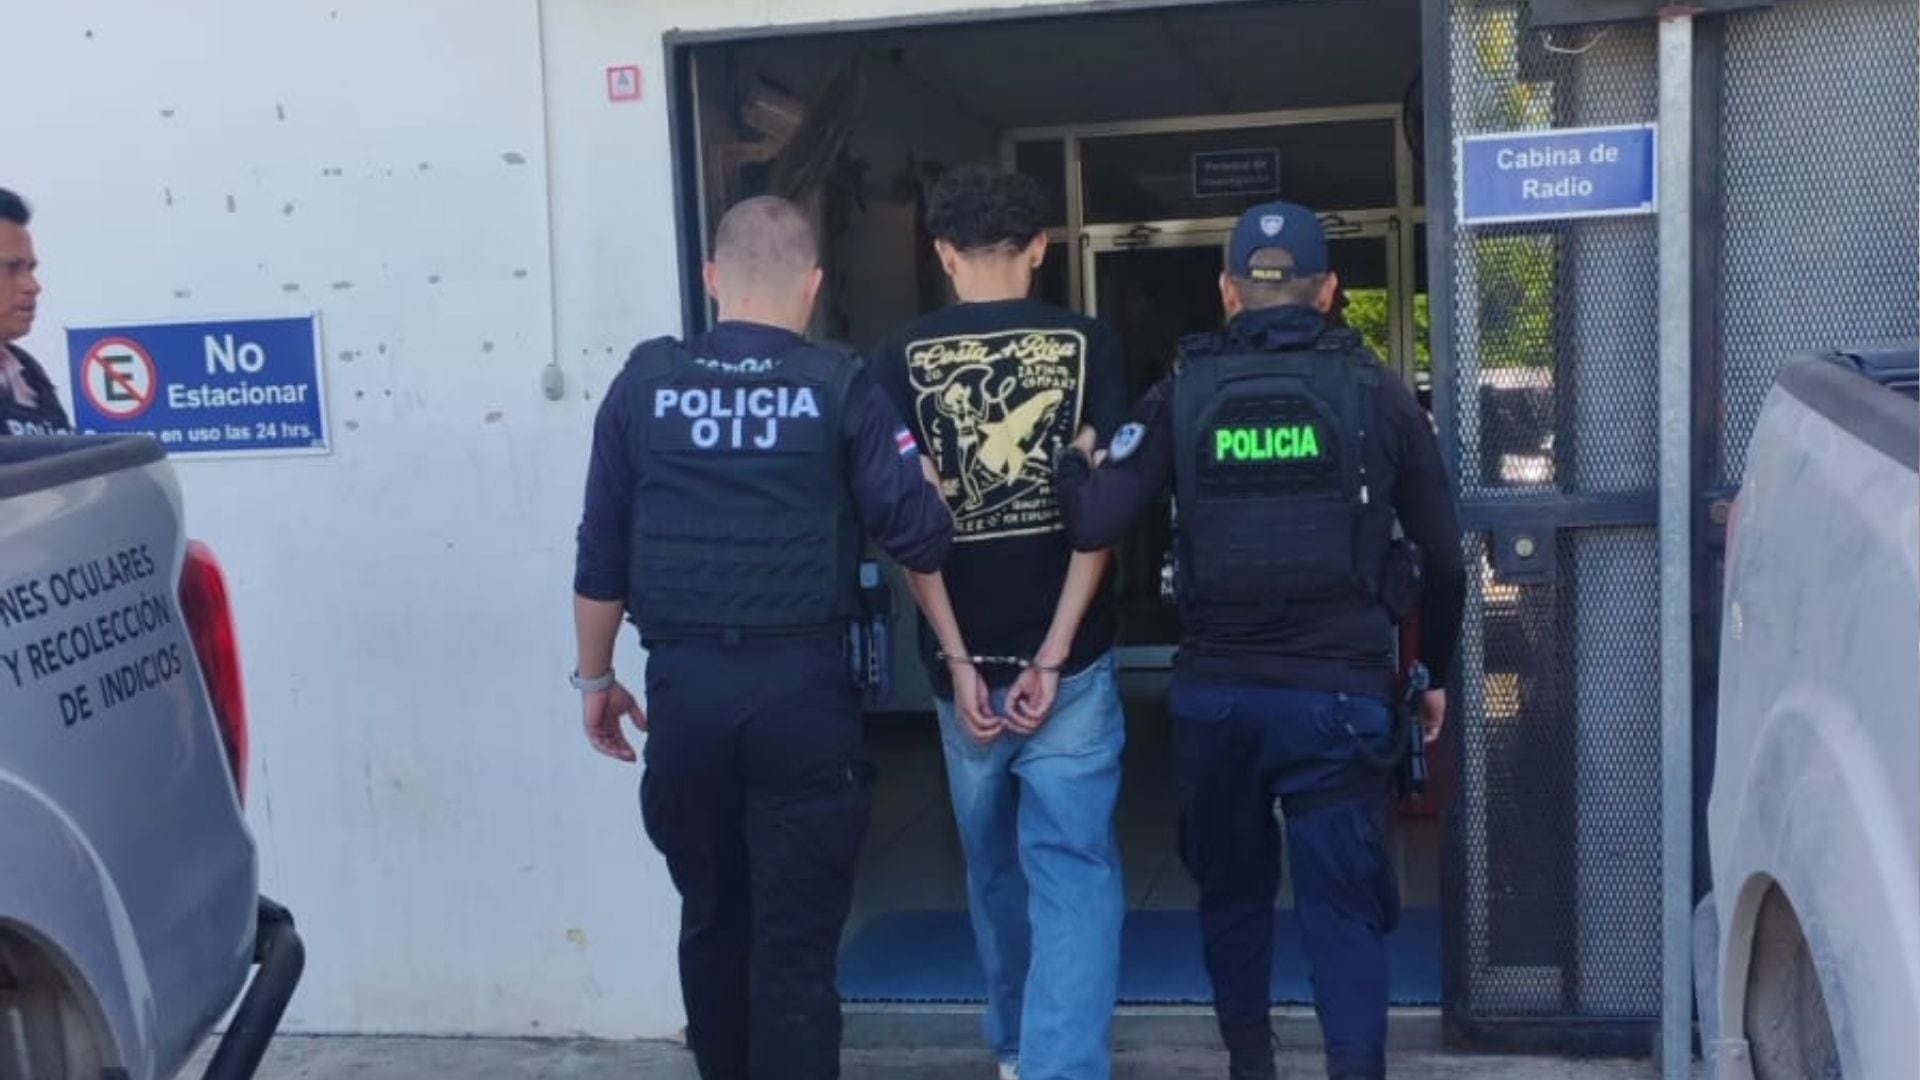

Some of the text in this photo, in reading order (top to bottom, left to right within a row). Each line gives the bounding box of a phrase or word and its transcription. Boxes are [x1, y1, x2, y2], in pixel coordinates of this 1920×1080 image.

[1496, 142, 1619, 170] Cabina de
[1522, 176, 1593, 200] Radio
[204, 334, 265, 375] No
[167, 383, 308, 409] Estacionar
[655, 387, 820, 419] POLICIA
[161, 429, 182, 443] en
[188, 426, 221, 442] uso
[225, 423, 249, 441] las
[256, 423, 276, 440] 24
[1216, 425, 1319, 461] POLICIA
[49, 544, 155, 607] OCULARES
[0, 592, 172, 688] Y RECOLECCIÓN
[58, 643, 183, 728] DE INDICIOS
